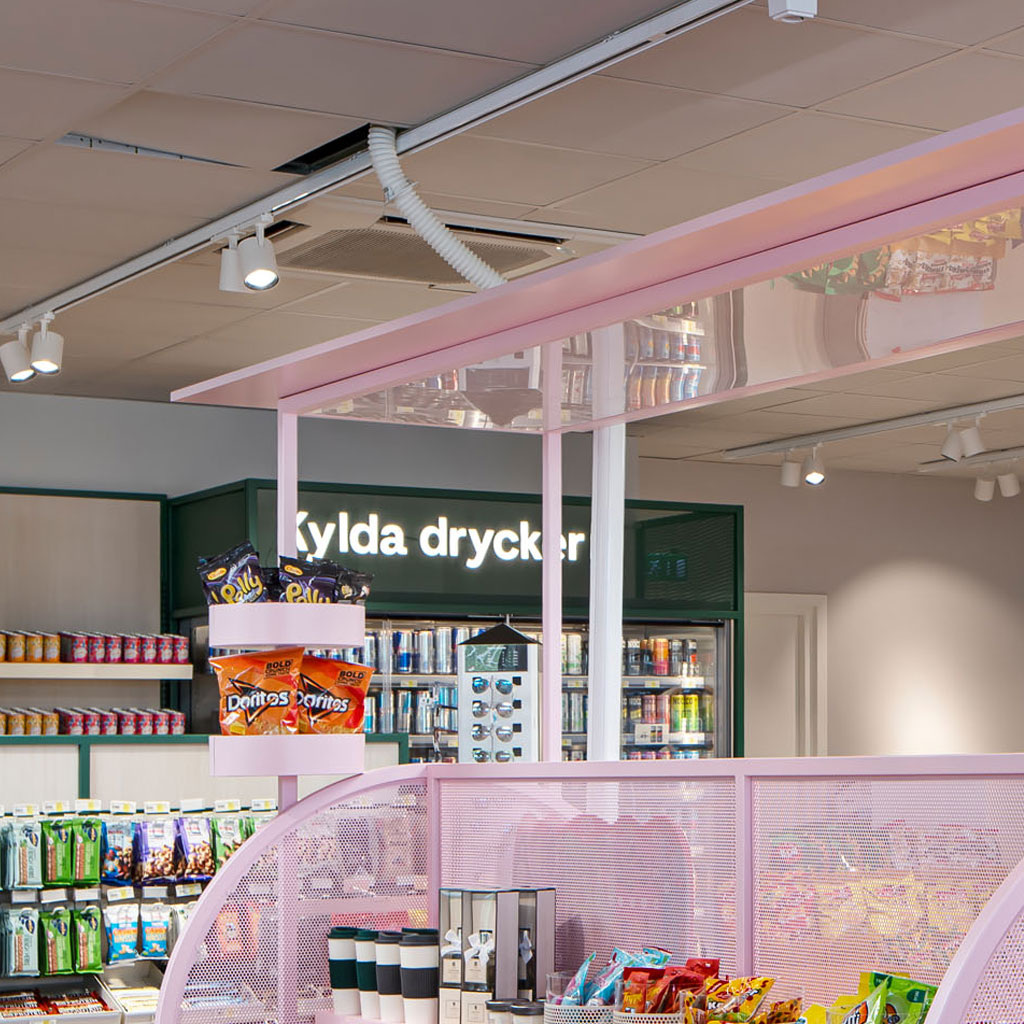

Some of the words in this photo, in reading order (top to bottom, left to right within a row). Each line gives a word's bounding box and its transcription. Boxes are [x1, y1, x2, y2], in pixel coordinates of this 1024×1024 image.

[266, 659, 293, 669] BOLD
[339, 670, 365, 680] BOLD
[227, 691, 290, 712] Doritos
